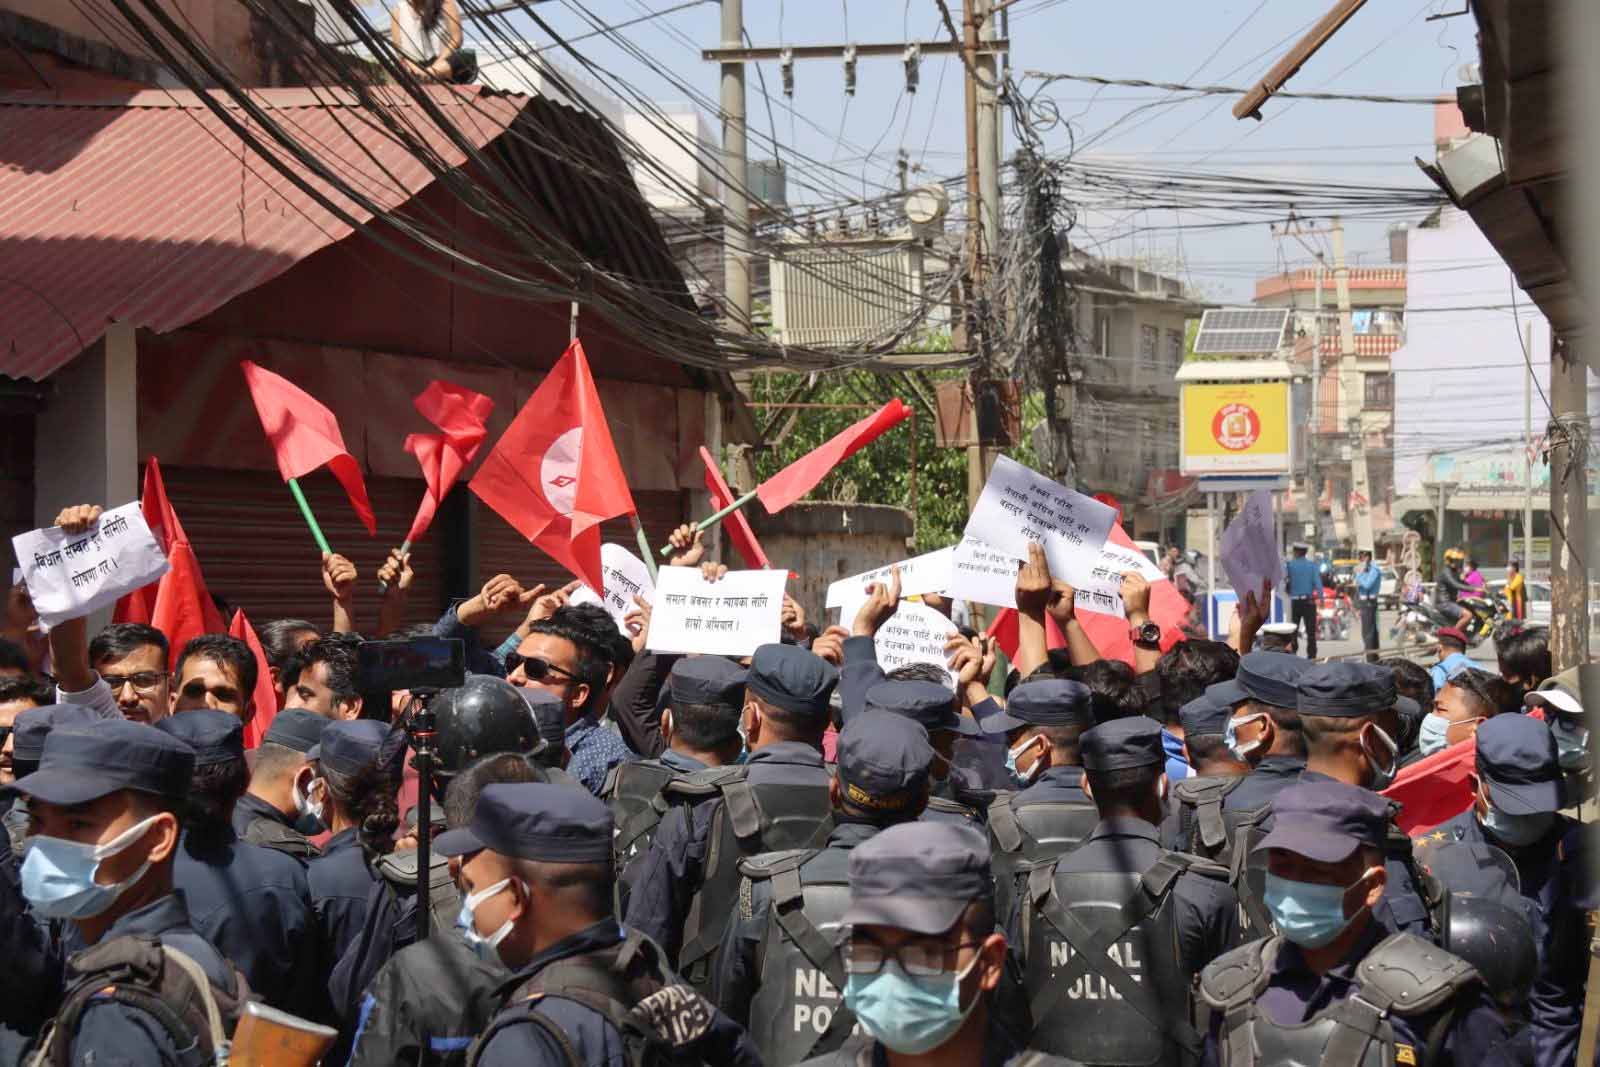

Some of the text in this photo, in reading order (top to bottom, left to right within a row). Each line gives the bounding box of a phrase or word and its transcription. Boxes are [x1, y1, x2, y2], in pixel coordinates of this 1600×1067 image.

[72, 566, 98, 588] घोषणा
[666, 593, 687, 606] समान
[715, 597, 721, 608] र
[751, 593, 768, 608] लागि
[705, 616, 734, 630] अभियान
[1050, 941, 1141, 968] NAL
